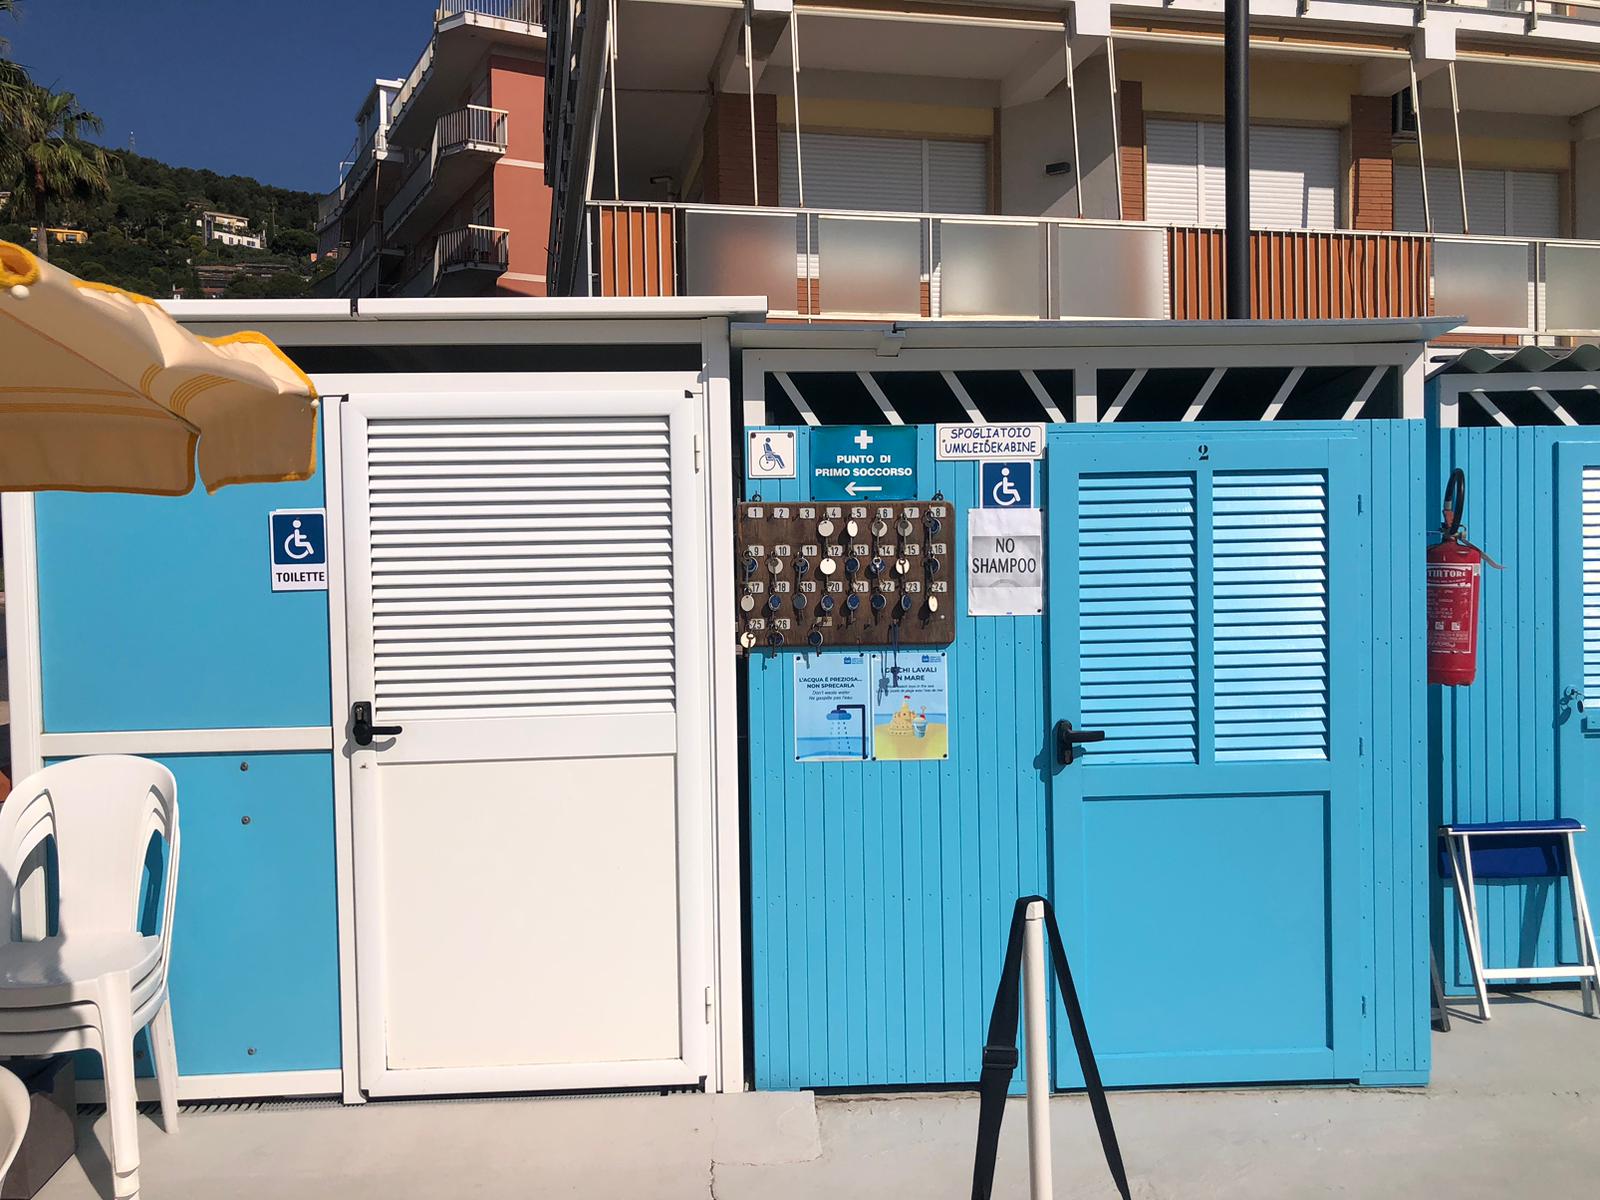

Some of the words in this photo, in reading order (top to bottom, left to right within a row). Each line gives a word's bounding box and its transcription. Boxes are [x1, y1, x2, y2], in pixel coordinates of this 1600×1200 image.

[950, 427, 1031, 439] SPOGLIATOIO
[945, 441, 1036, 453] UMKLEIDEKABINE
[1198, 444, 1209, 461] 2
[836, 455, 875, 464] PUNTO
[879, 455, 891, 463] DI
[815, 468, 851, 477] PRIMO
[852, 467, 913, 477] SOCCORSO
[778, 509, 784, 518] 2
[804, 509, 810, 518] 3
[831, 509, 837, 517] 4
[856, 509, 862, 518] 5
[882, 509, 888, 518] 6
[909, 509, 914, 518] 7
[935, 508, 941, 517] 8
[935, 545, 943, 554] 16
[995, 538, 1015, 553] NO
[753, 546, 759, 556] 9
[779, 547, 787, 556] 10
[805, 546, 813, 555] 11
[831, 547, 839, 556] 12
[857, 546, 866, 555] 13
[883, 547, 891, 556] 14
[907, 546, 916, 555] 15
[972, 557, 1037, 574] SHAMPOO
[276, 572, 325, 582] TOILETTE
[752, 583, 760, 592] 17
[778, 583, 786, 592] 18
[804, 583, 813, 592] 19
[831, 583, 840, 592] 20
[857, 583, 865, 592] 21
[883, 583, 892, 592] 22
[909, 582, 918, 591] 23
[778, 620, 787, 629] 26
